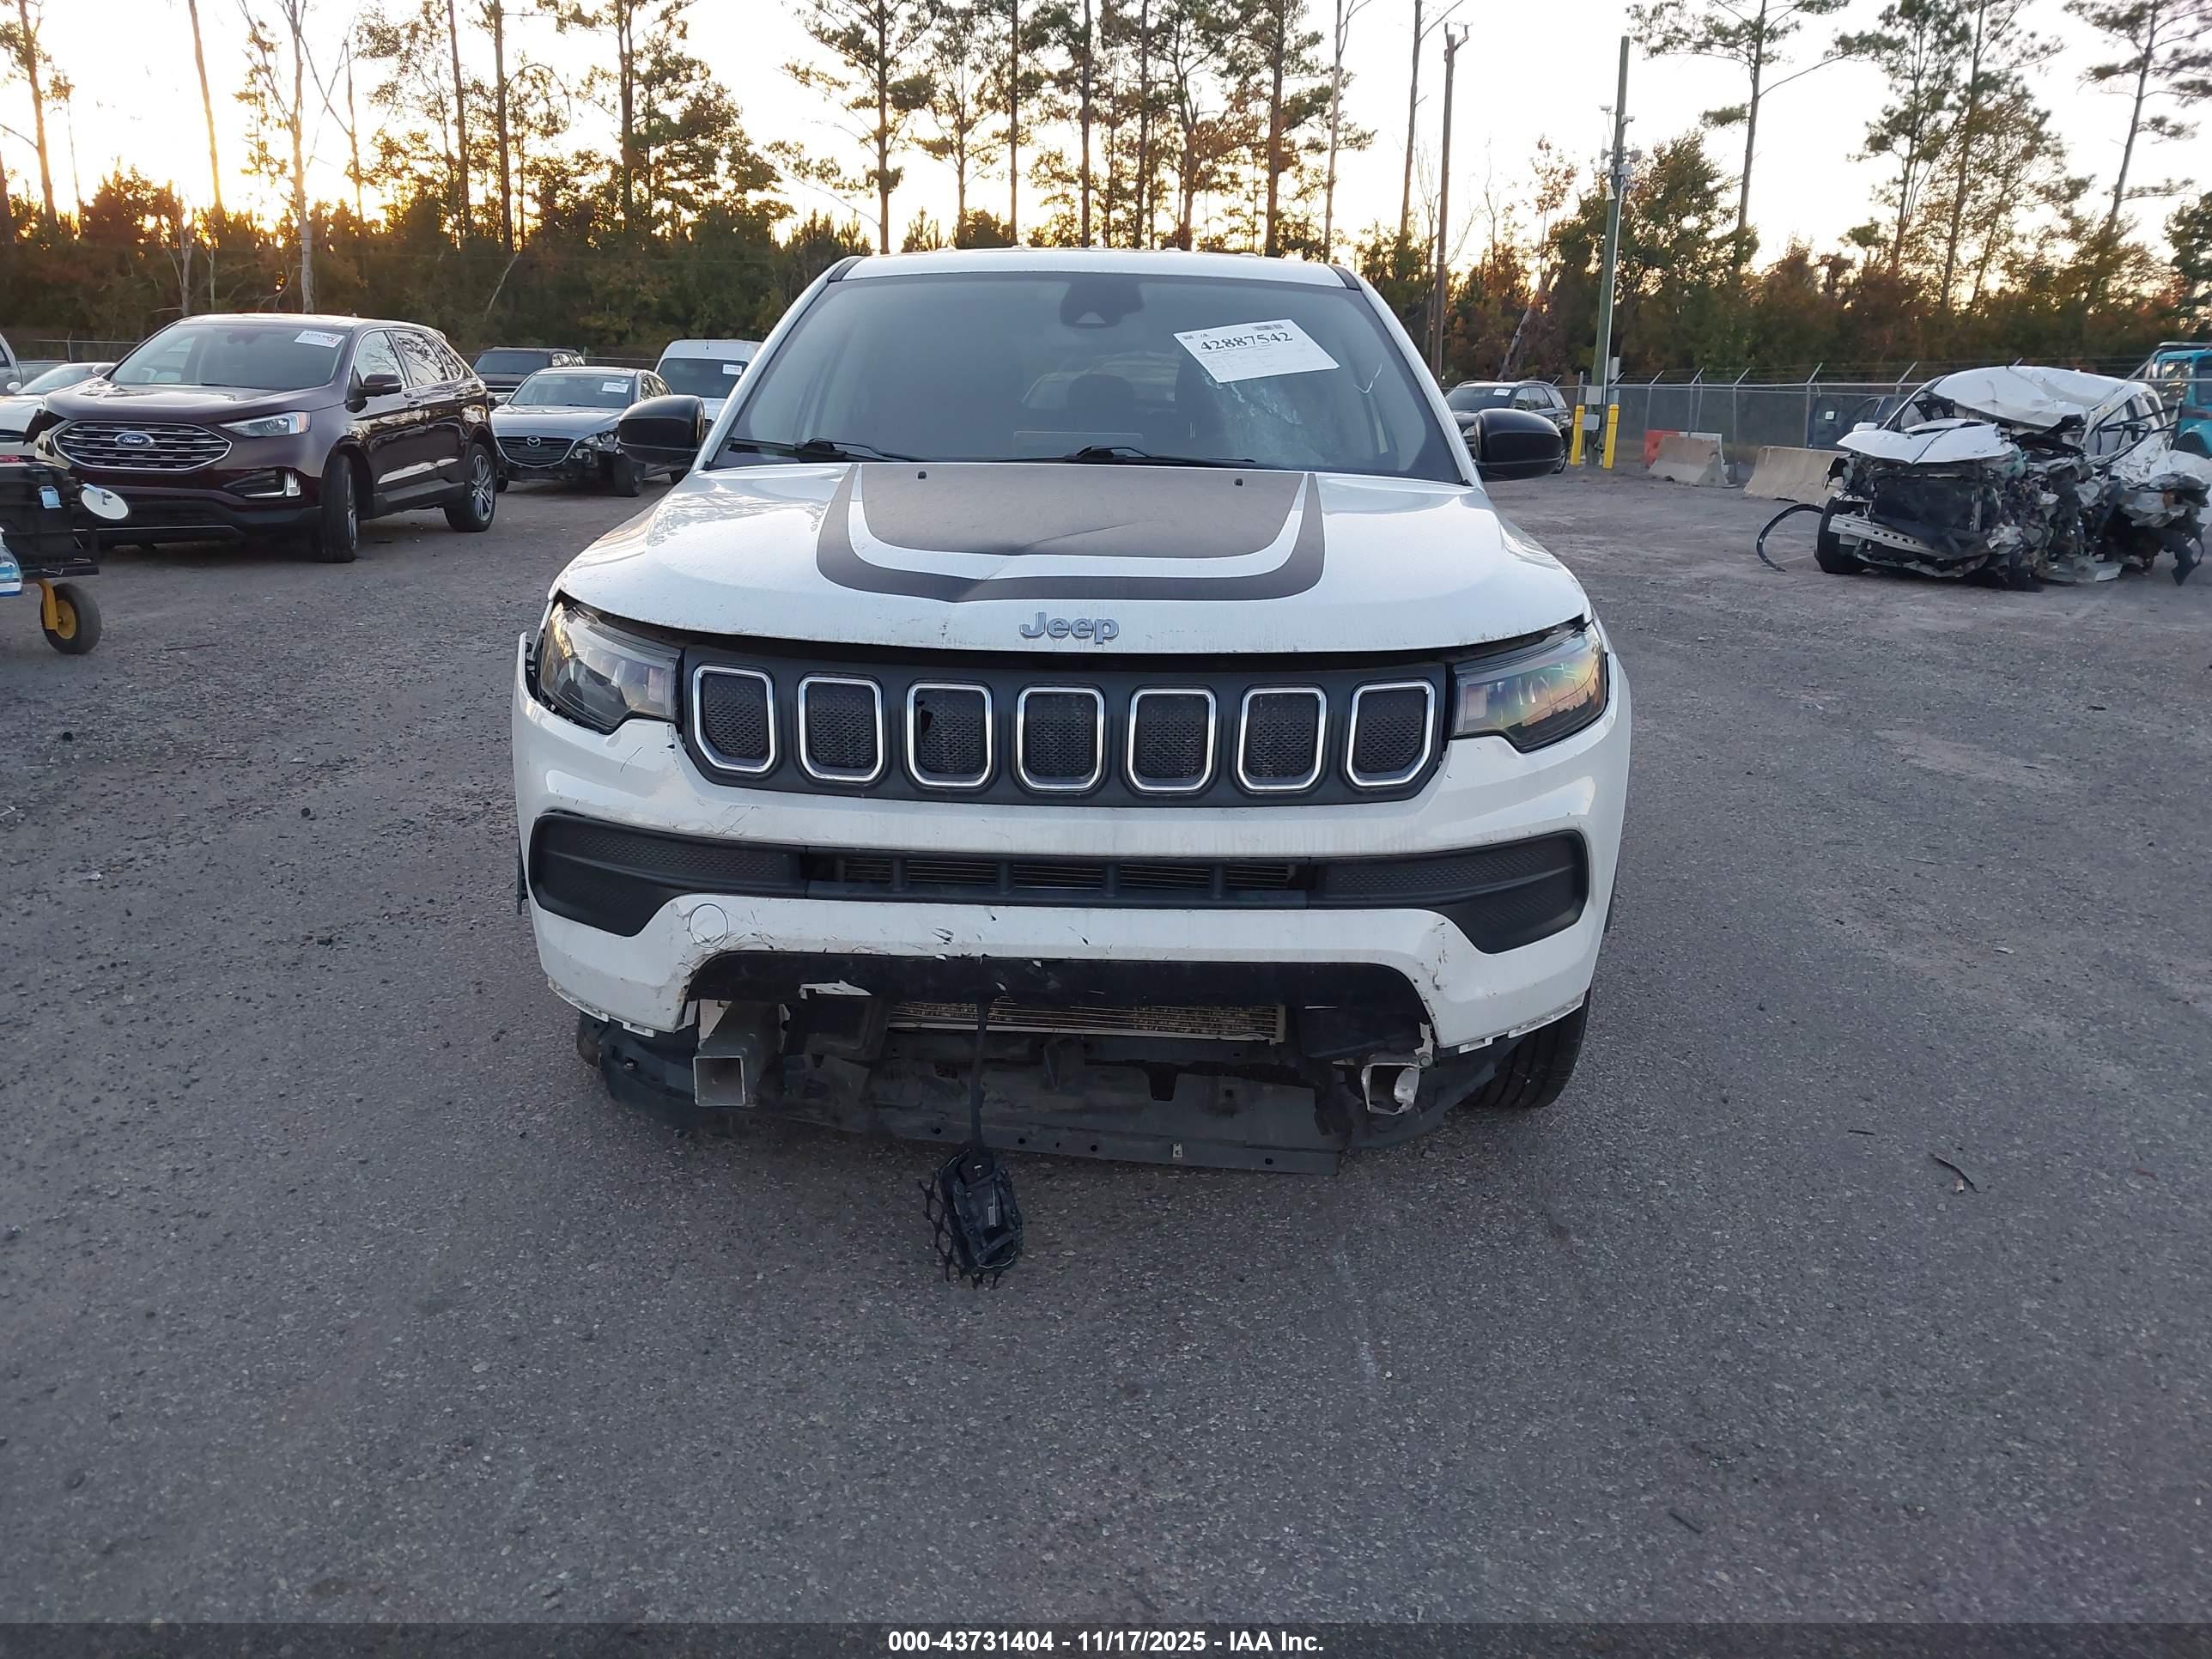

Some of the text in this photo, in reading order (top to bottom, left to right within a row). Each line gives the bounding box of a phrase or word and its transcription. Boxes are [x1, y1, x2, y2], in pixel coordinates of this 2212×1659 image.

[1200, 332, 1293, 352] 42887542
[123, 435, 143, 444] Ford
[1019, 612, 1119, 644] Jeep
